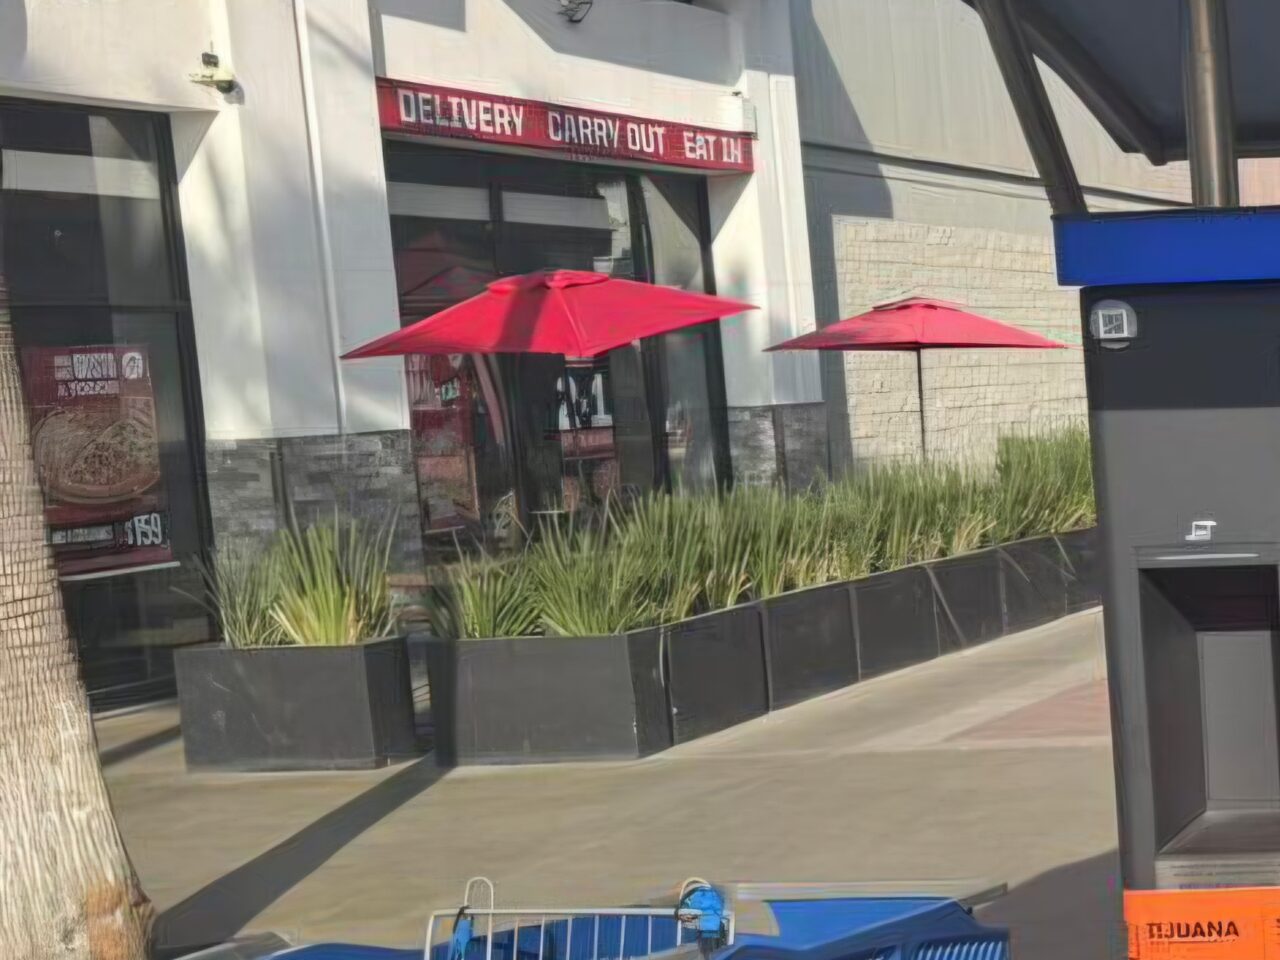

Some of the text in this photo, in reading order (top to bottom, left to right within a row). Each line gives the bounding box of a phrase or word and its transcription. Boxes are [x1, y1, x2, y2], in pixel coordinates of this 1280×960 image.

[398, 89, 525, 137] DELIVERY
[548, 111, 620, 149] CARRY
[625, 120, 666, 156] OUT
[683, 130, 716, 161] EAT
[1146, 920, 1241, 940] TIJUANA
